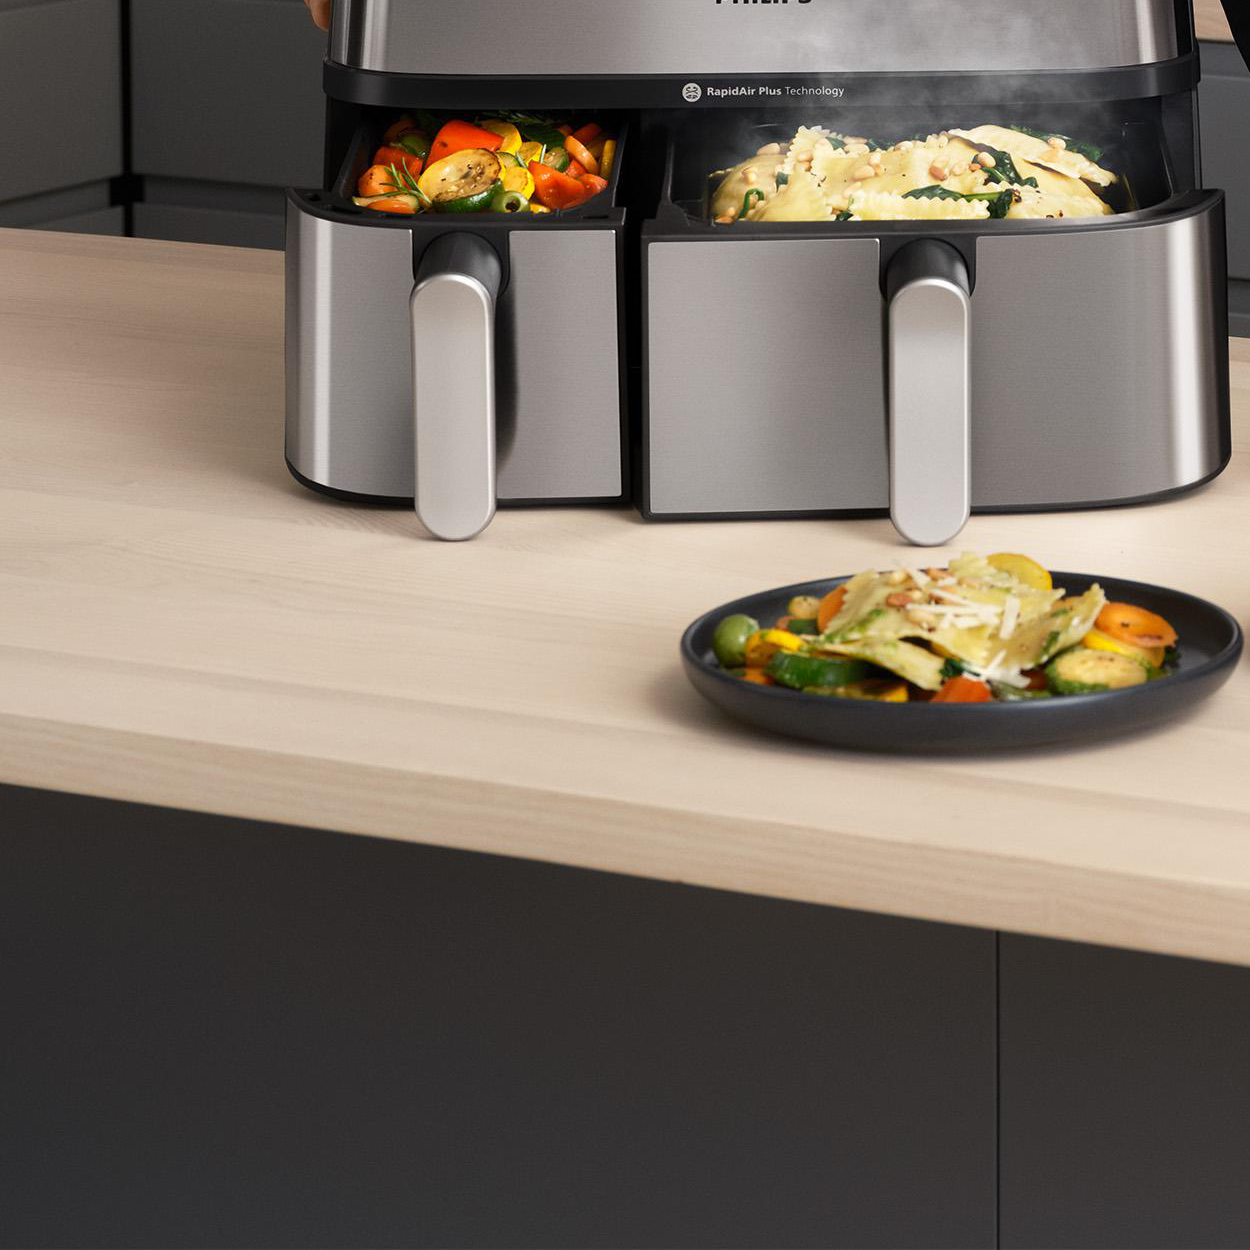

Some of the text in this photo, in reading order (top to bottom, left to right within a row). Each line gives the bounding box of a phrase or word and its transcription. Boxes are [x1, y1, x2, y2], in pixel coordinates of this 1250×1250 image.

[706, 86, 845, 98] RapidAir Plus Technology
